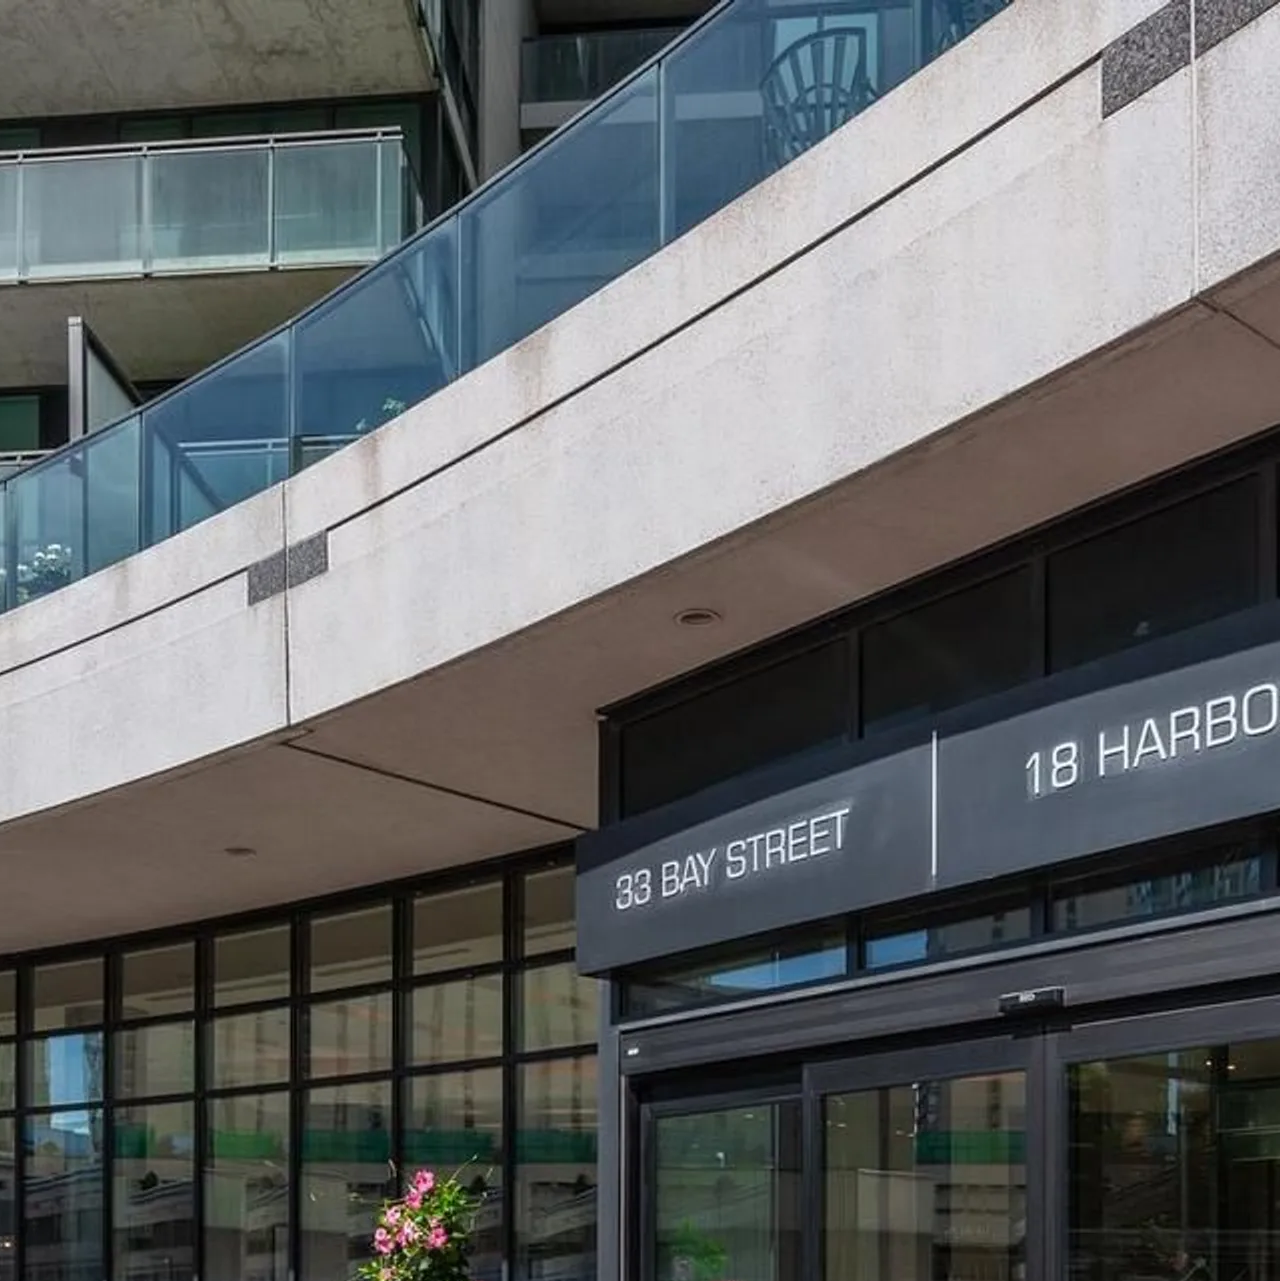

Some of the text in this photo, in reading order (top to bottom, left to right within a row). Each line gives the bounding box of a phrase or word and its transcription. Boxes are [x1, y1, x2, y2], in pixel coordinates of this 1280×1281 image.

[1025, 742, 1078, 797] 18
[616, 807, 850, 910] 33 BAY STREET
